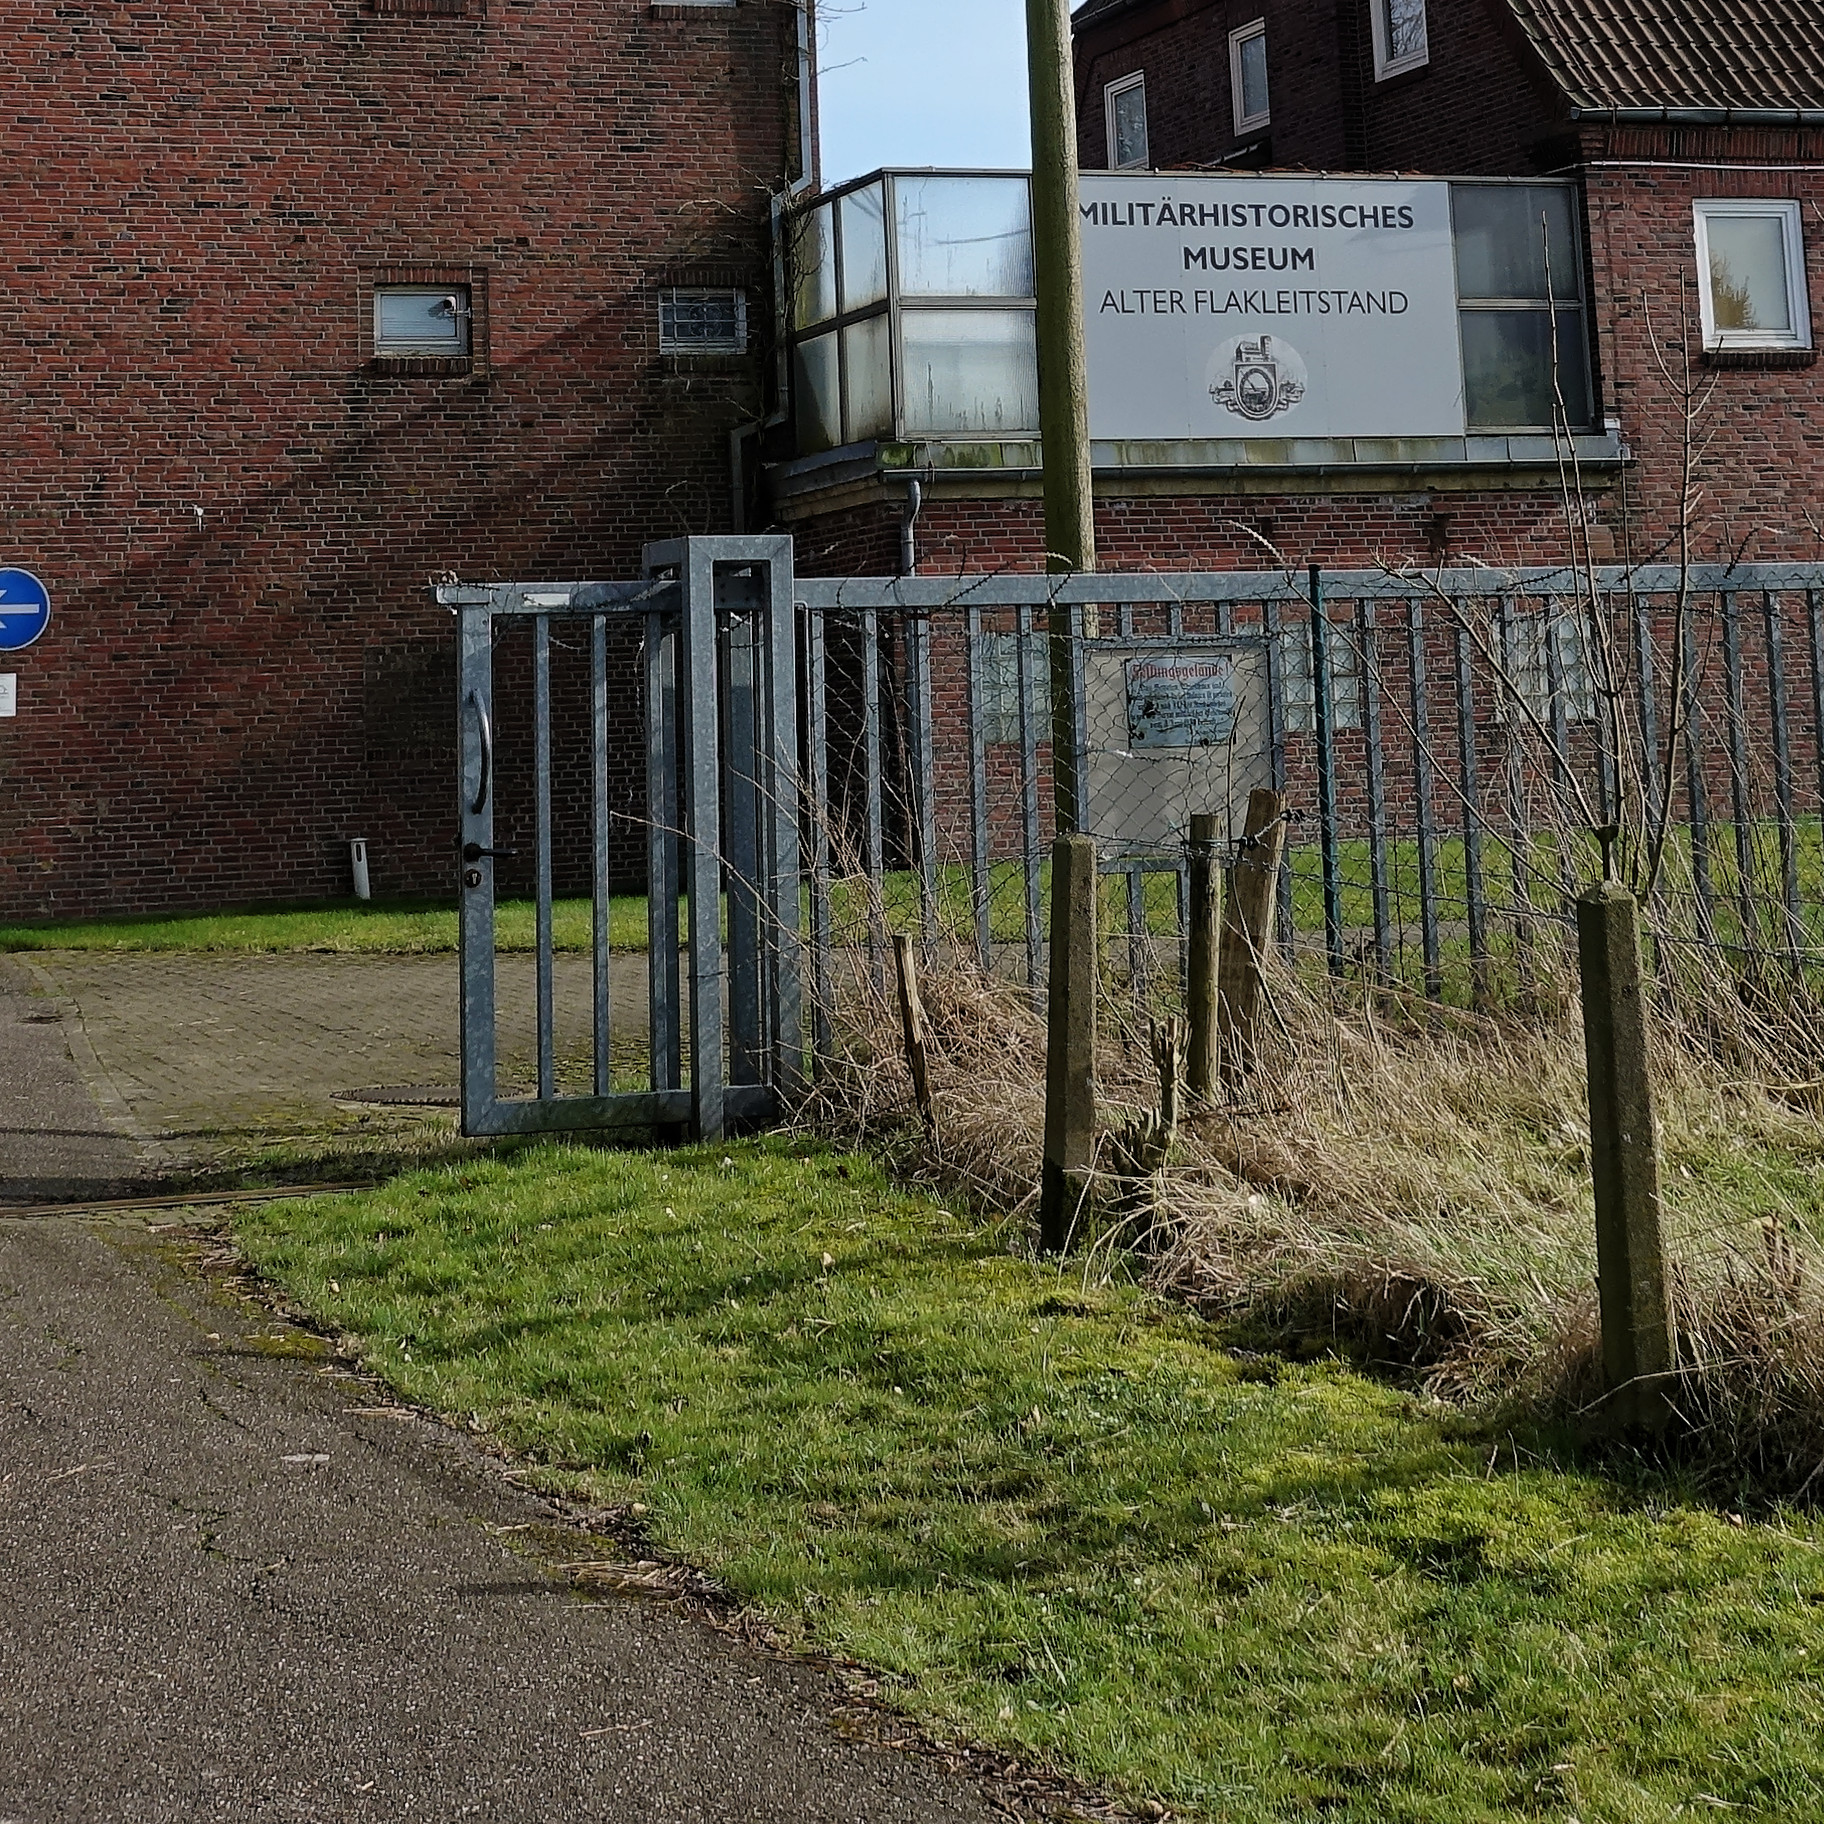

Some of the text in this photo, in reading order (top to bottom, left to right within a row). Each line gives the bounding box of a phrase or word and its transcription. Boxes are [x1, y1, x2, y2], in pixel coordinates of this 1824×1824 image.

[1079, 195, 1415, 230] MILITÄRHISTORISCHES
[1183, 246, 1316, 271] MUSEUM
[1099, 289, 1410, 315] ALTER FLAKLEITSTAND
